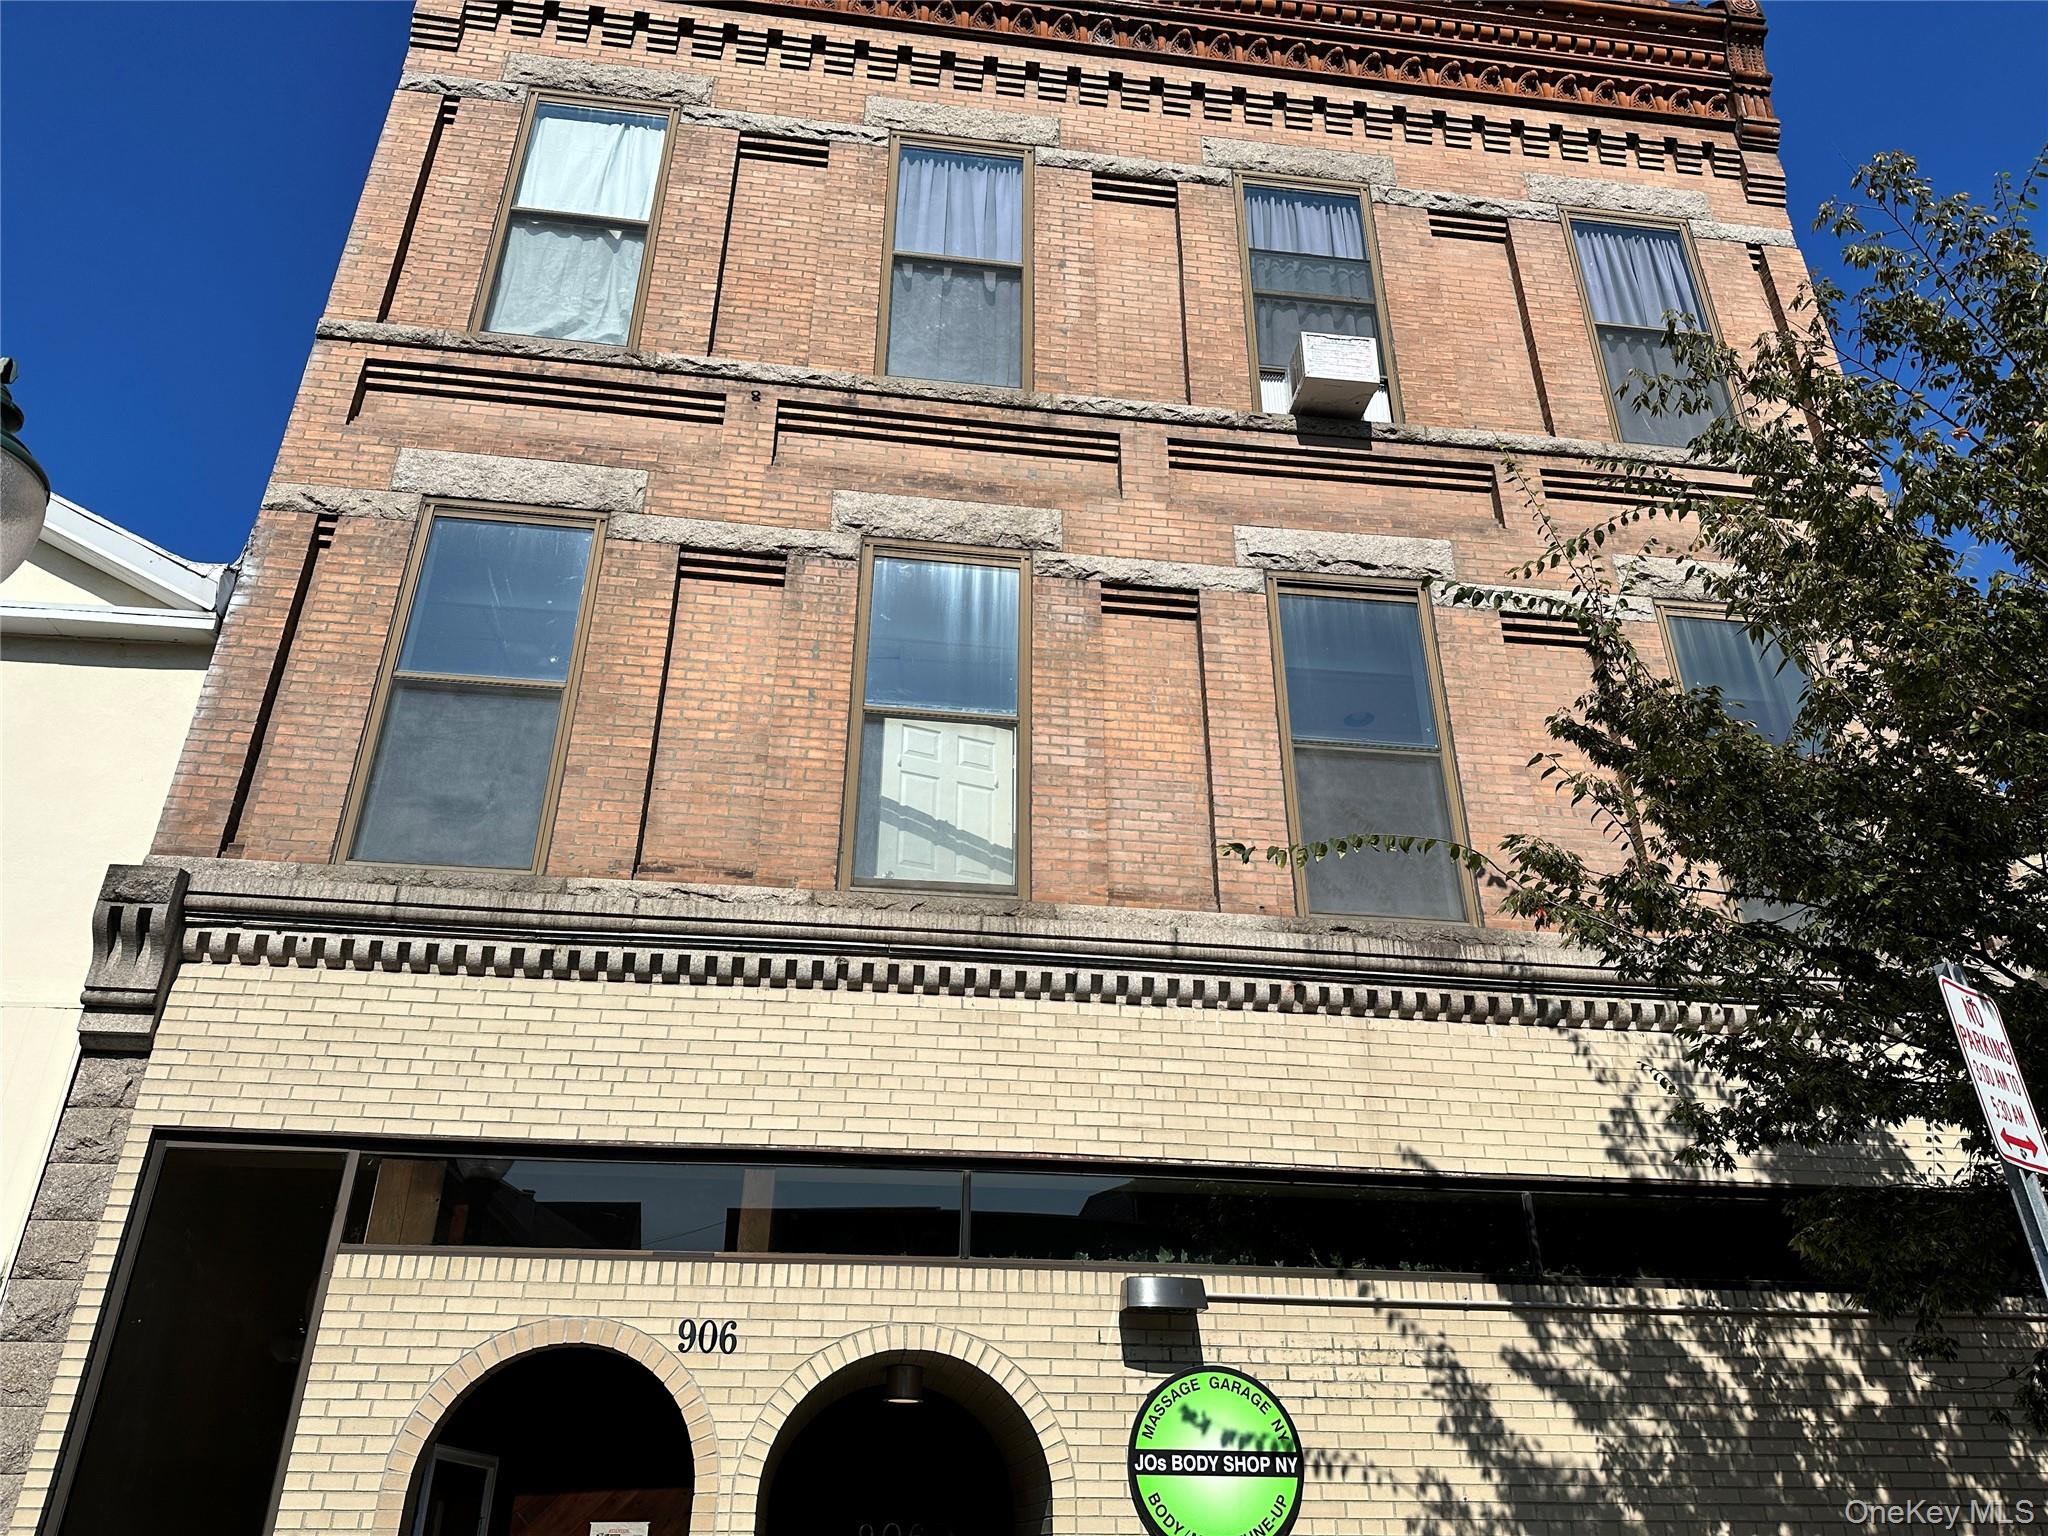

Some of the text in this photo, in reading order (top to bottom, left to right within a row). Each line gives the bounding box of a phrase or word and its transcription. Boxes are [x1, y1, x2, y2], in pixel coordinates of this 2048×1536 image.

[1962, 996, 1985, 1028] NO
[1958, 1023, 2012, 1066] PARKING
[1972, 1059, 2022, 1097] 3:00 AM TO
[1990, 1095, 2028, 1128] 5:30 AM
[678, 1319, 737, 1354] 906
[1141, 1376, 1290, 1443] MASSAGE GARAGE NY
[1134, 1454, 1298, 1474] JOs BODY SHOP NY
